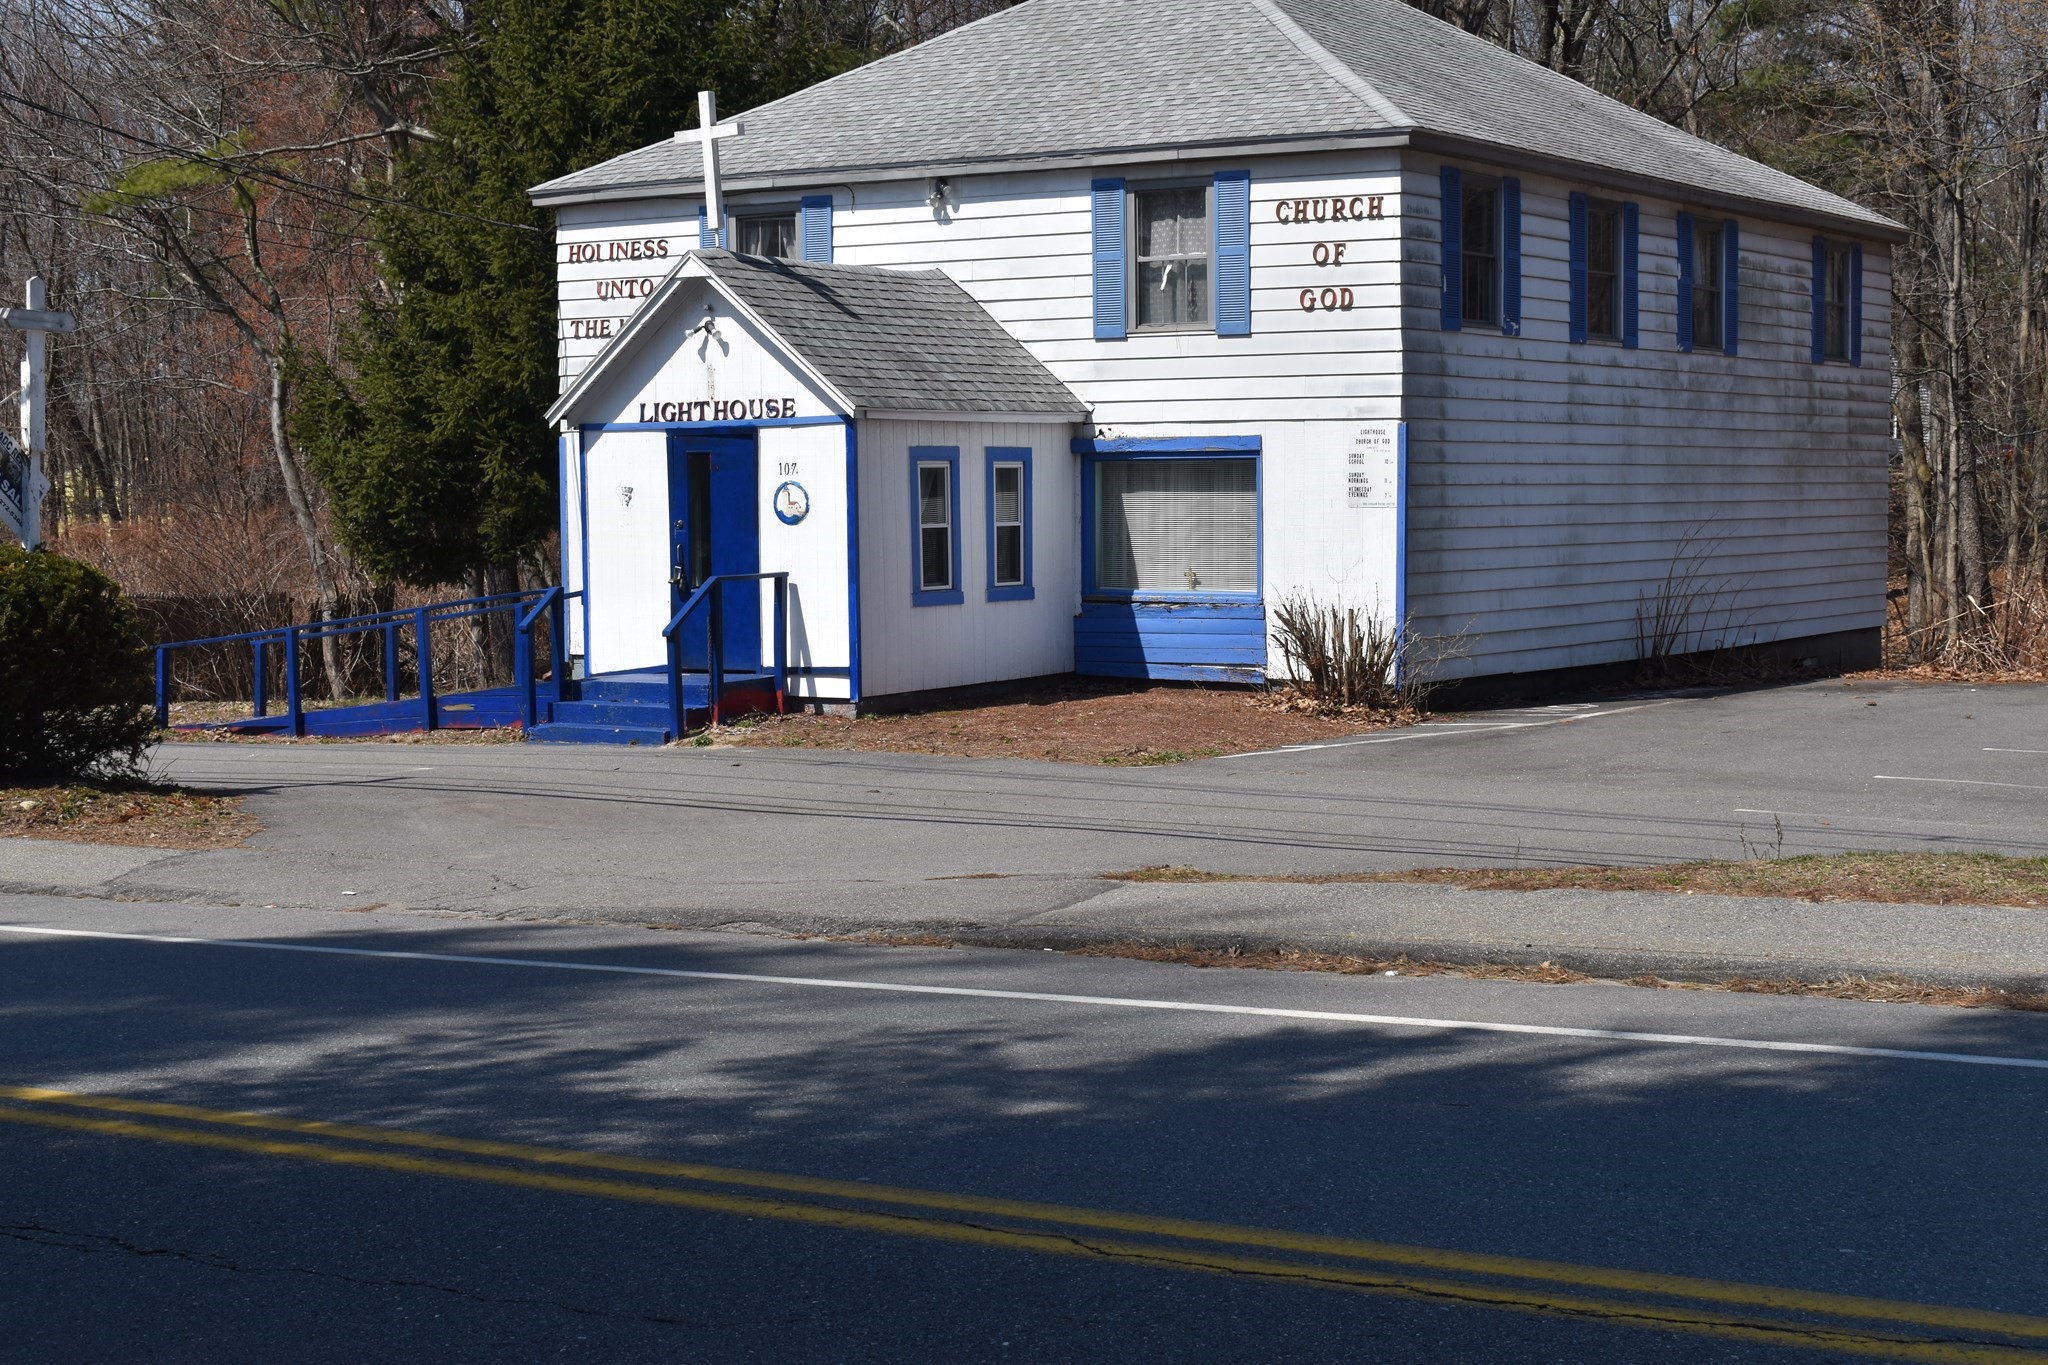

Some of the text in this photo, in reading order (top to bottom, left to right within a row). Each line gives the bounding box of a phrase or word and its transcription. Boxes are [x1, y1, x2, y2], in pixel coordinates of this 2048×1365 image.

[1276, 197, 1384, 224] CHURCH
[569, 239, 668, 264] HOLINESS
[1313, 243, 1346, 267] OF
[597, 279, 653, 301] UNTO
[1300, 287, 1354, 313] GOD
[571, 319, 611, 340] THE
[639, 398, 797, 423] LIGHTHOUSE
